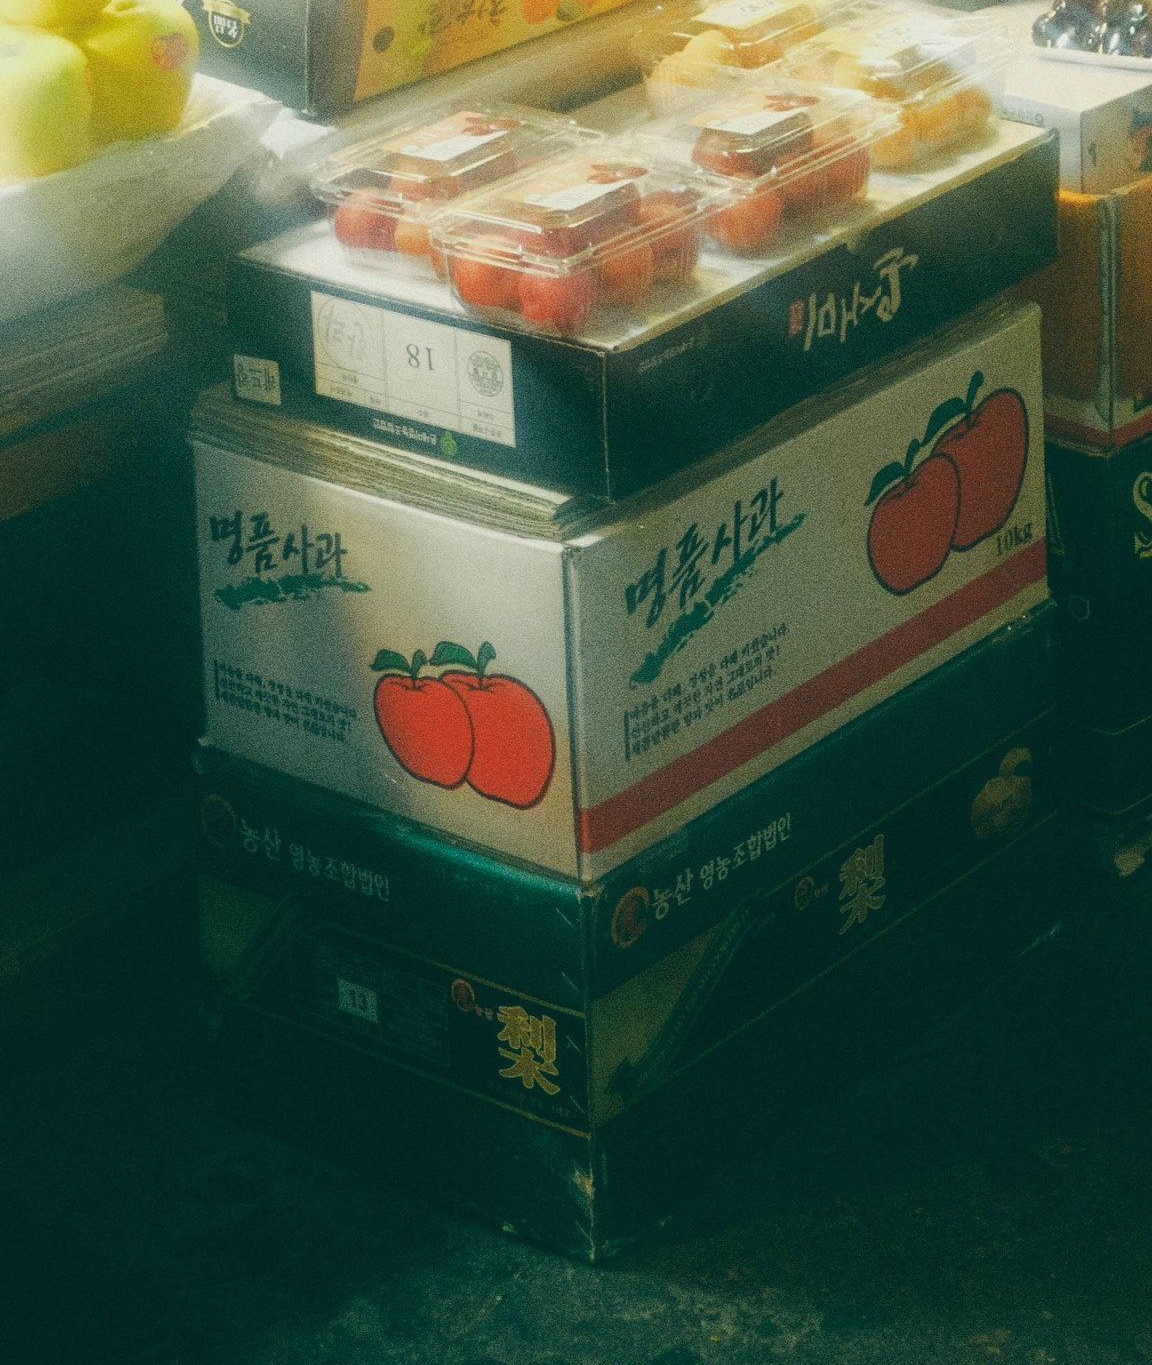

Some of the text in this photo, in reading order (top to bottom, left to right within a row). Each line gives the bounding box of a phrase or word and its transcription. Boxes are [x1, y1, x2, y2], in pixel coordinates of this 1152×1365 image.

[209, 509, 348, 578] 명품사과
[624, 476, 785, 630] 명품사과
[239, 817, 390, 903] 농산 영농조합법인
[651, 812, 793, 921] 농산 영농조합법인
